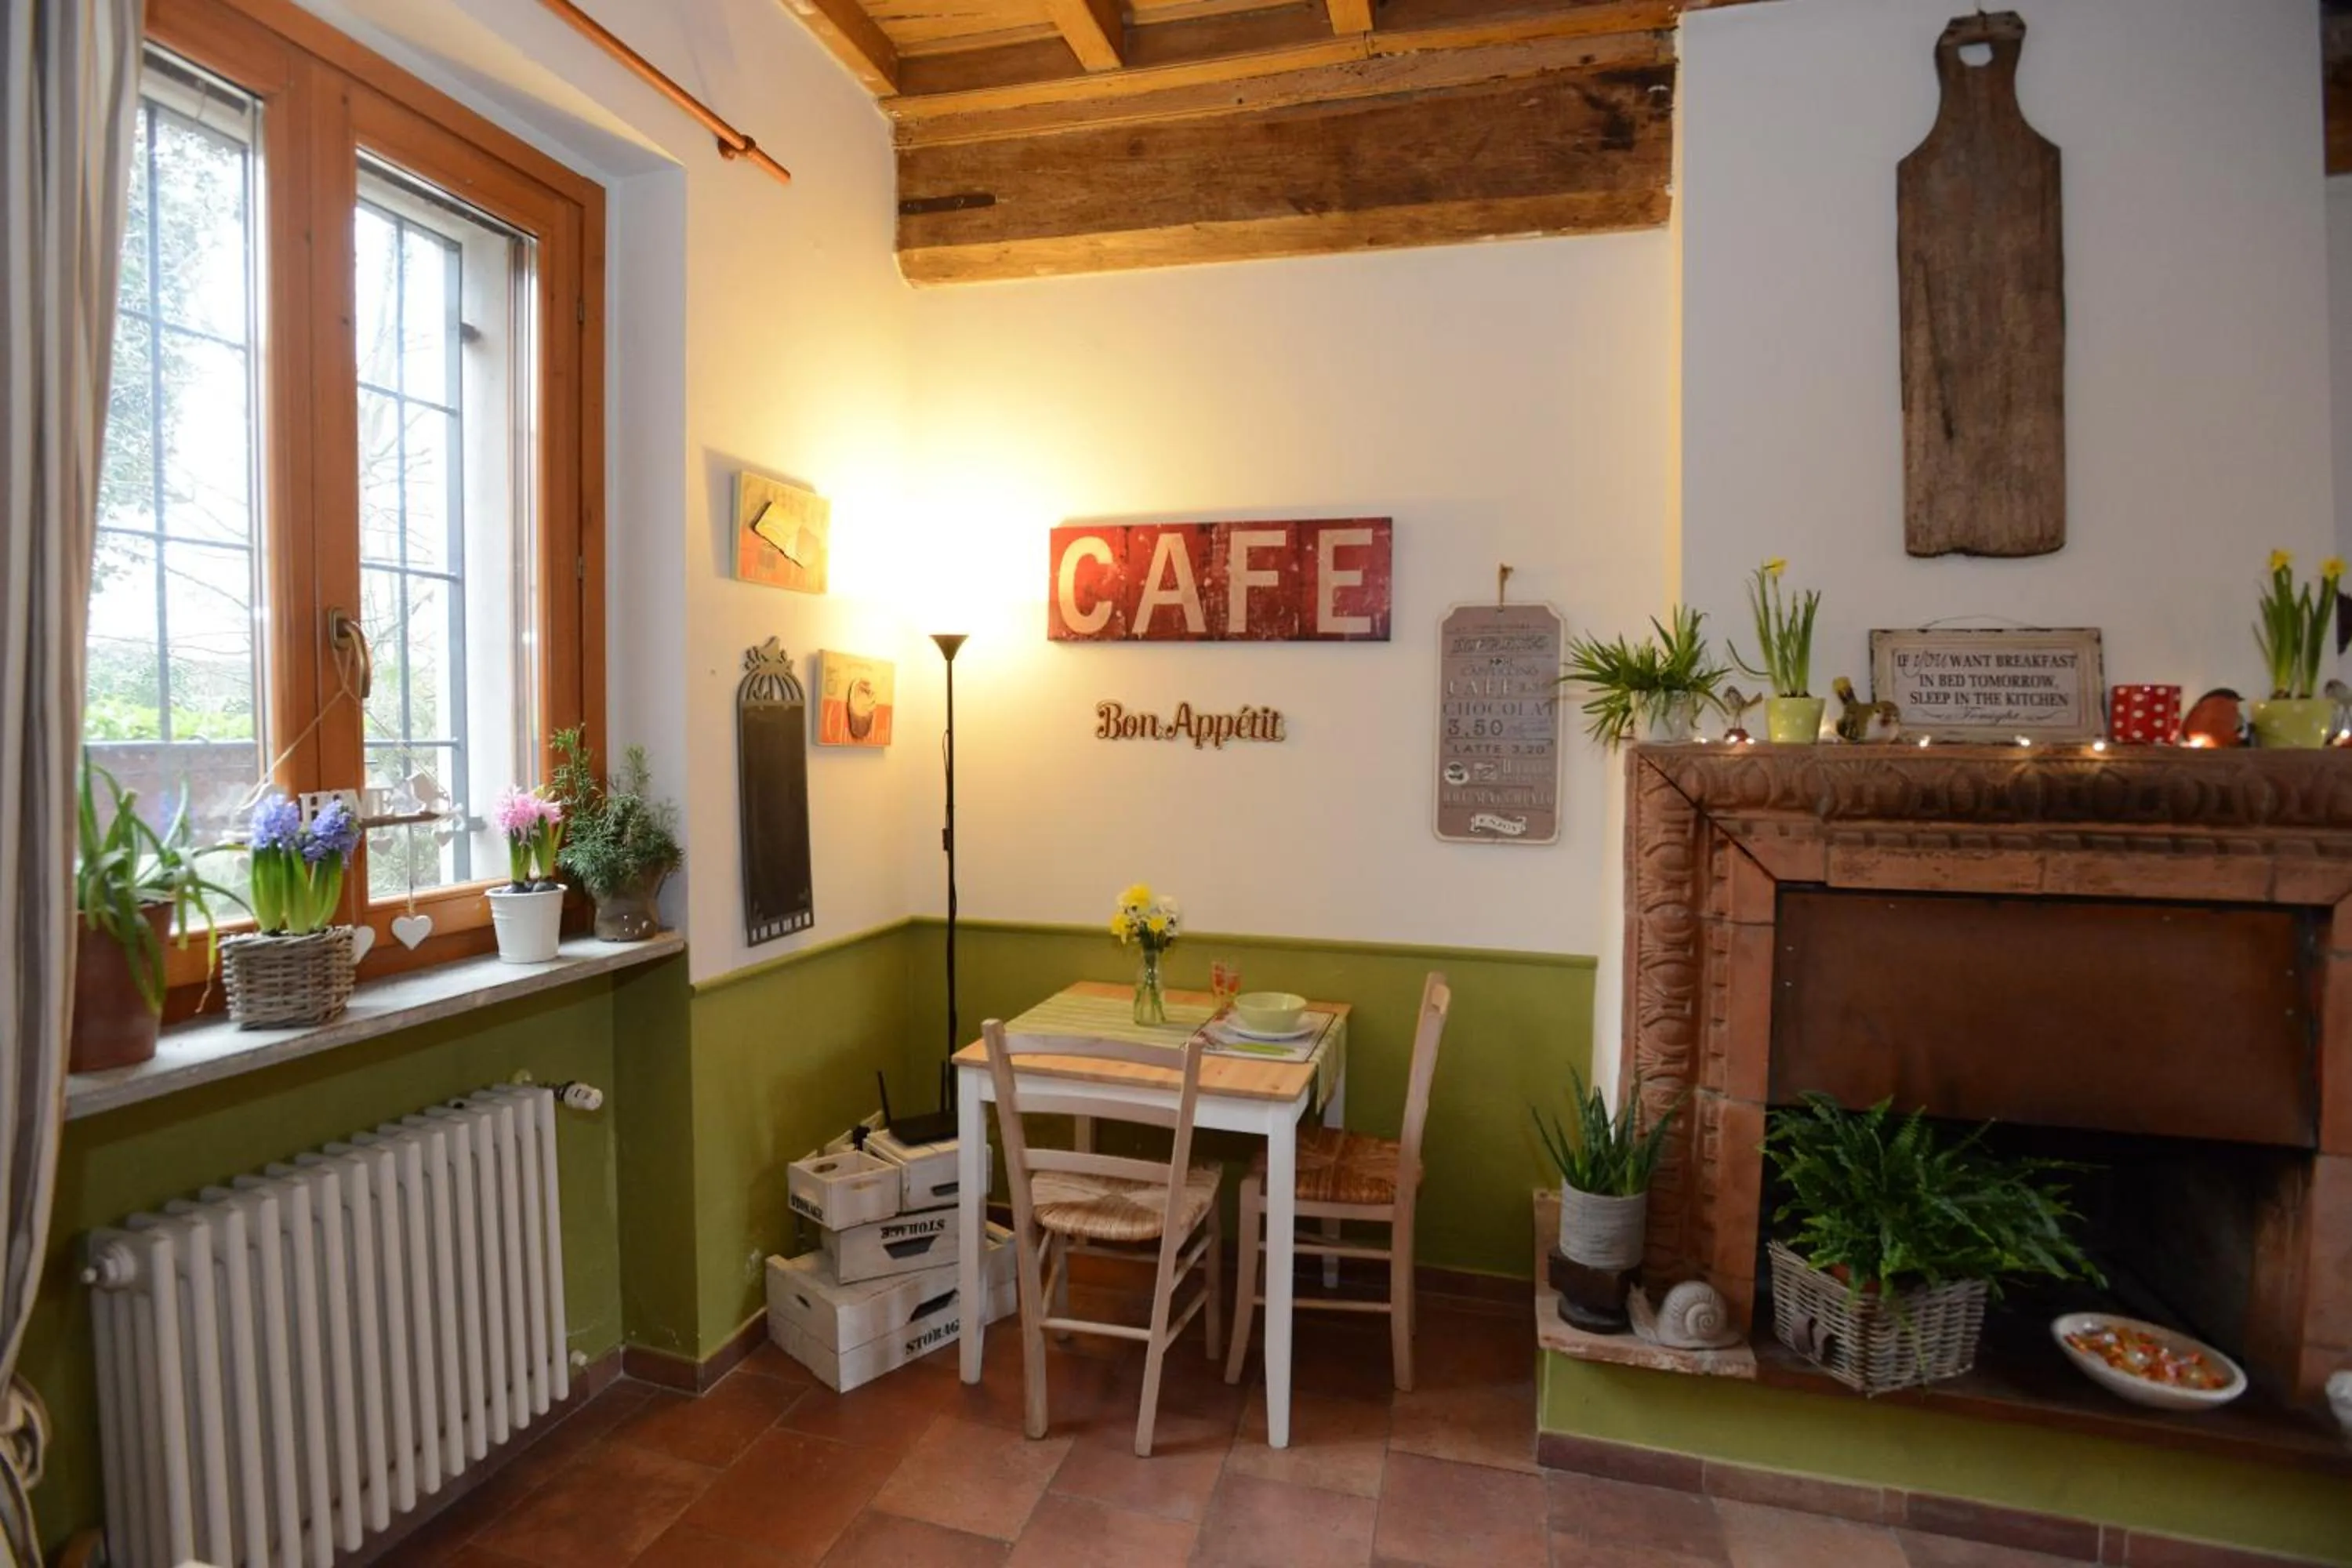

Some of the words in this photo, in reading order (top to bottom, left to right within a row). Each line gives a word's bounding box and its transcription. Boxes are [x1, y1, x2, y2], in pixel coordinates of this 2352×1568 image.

[1058, 528, 1373, 634] CAFE
[1897, 653, 1909, 667] IF
[1902, 650, 1947, 678] you
[1949, 654, 1991, 667] WANT
[1996, 653, 2077, 668] BREAKFAST
[1919, 674, 1934, 687] IN
[1938, 674, 1965, 687] BED
[1969, 674, 2060, 690] TOMORROW,
[1909, 691, 1951, 705] SLEEP
[1955, 691, 1969, 705] IN
[1973, 691, 2002, 706] THE
[2005, 692, 2069, 706] KITCHEN
[1962, 706, 2020, 724] Tonight
[1095, 699, 1161, 740] Bon
[1166, 702, 1286, 750] Appétit
[1453, 744, 1502, 754] LATTE
[906, 1319, 960, 1356] STORAG
